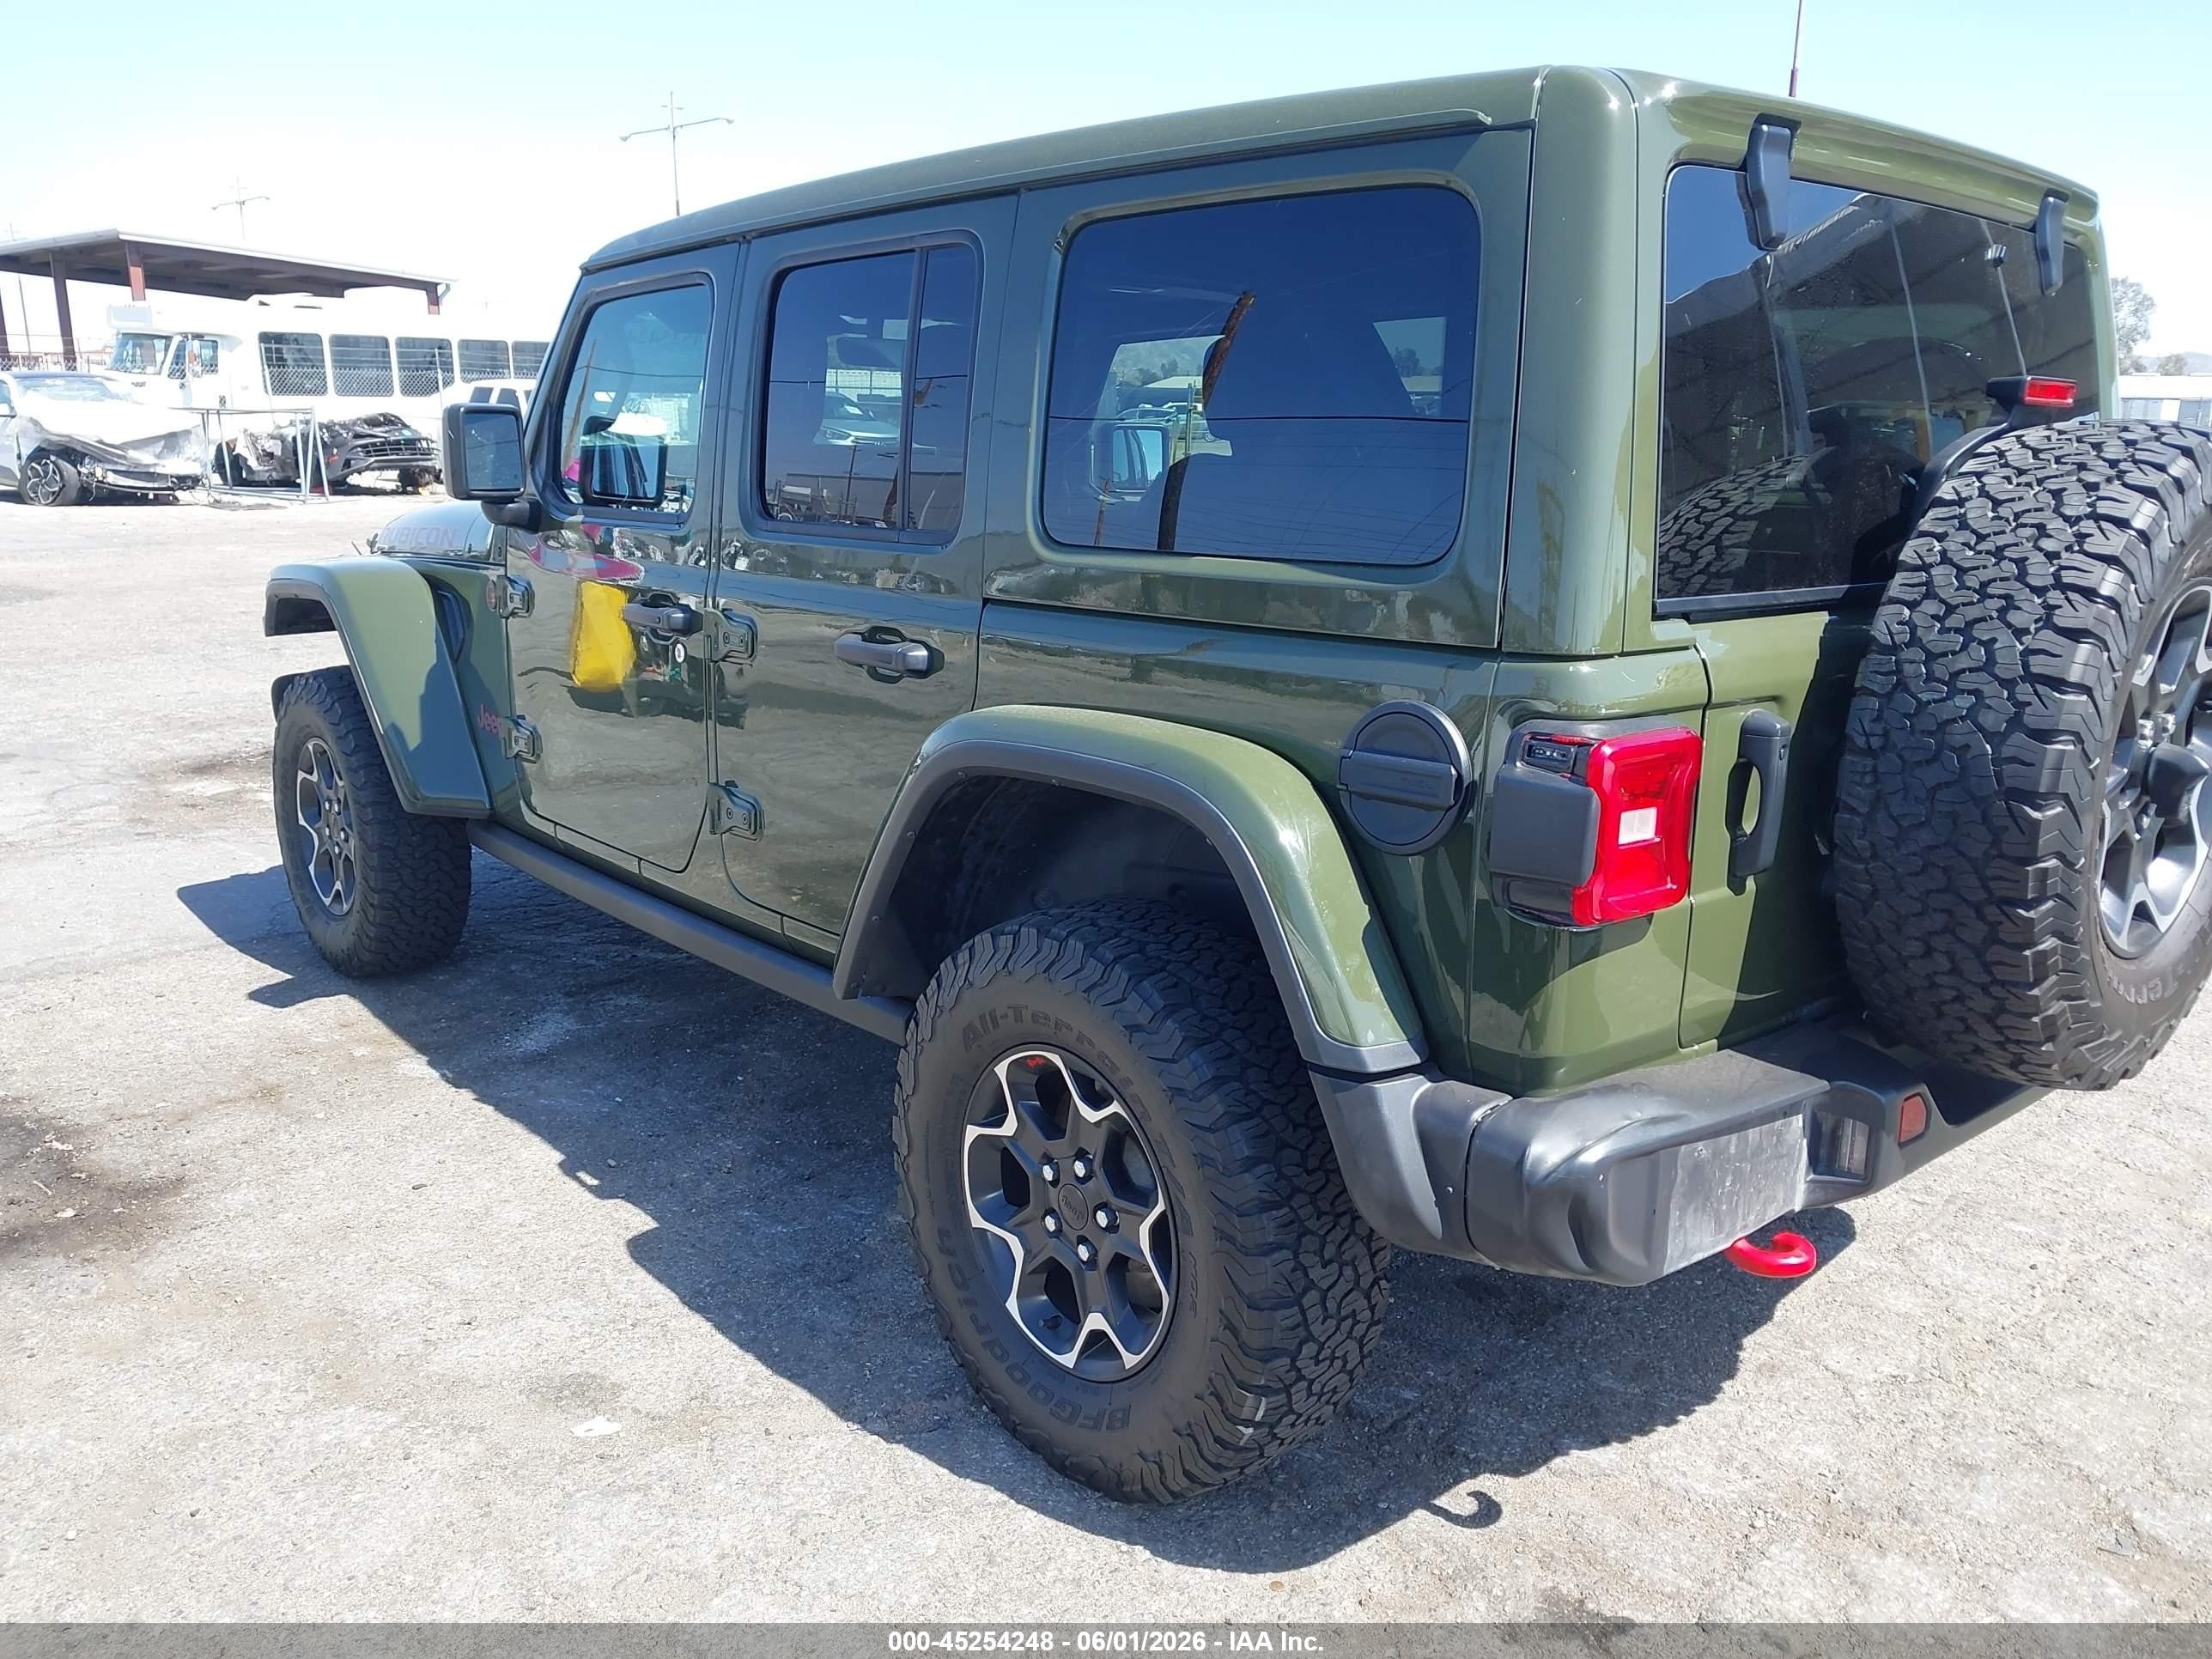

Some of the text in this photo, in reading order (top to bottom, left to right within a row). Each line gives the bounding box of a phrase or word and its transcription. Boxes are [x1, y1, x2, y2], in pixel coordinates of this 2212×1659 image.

[379, 527, 458, 547] RUBICON
[962, 1003, 1152, 1121] All-Terrain
[1061, 1194, 1085, 1222] Jeep
